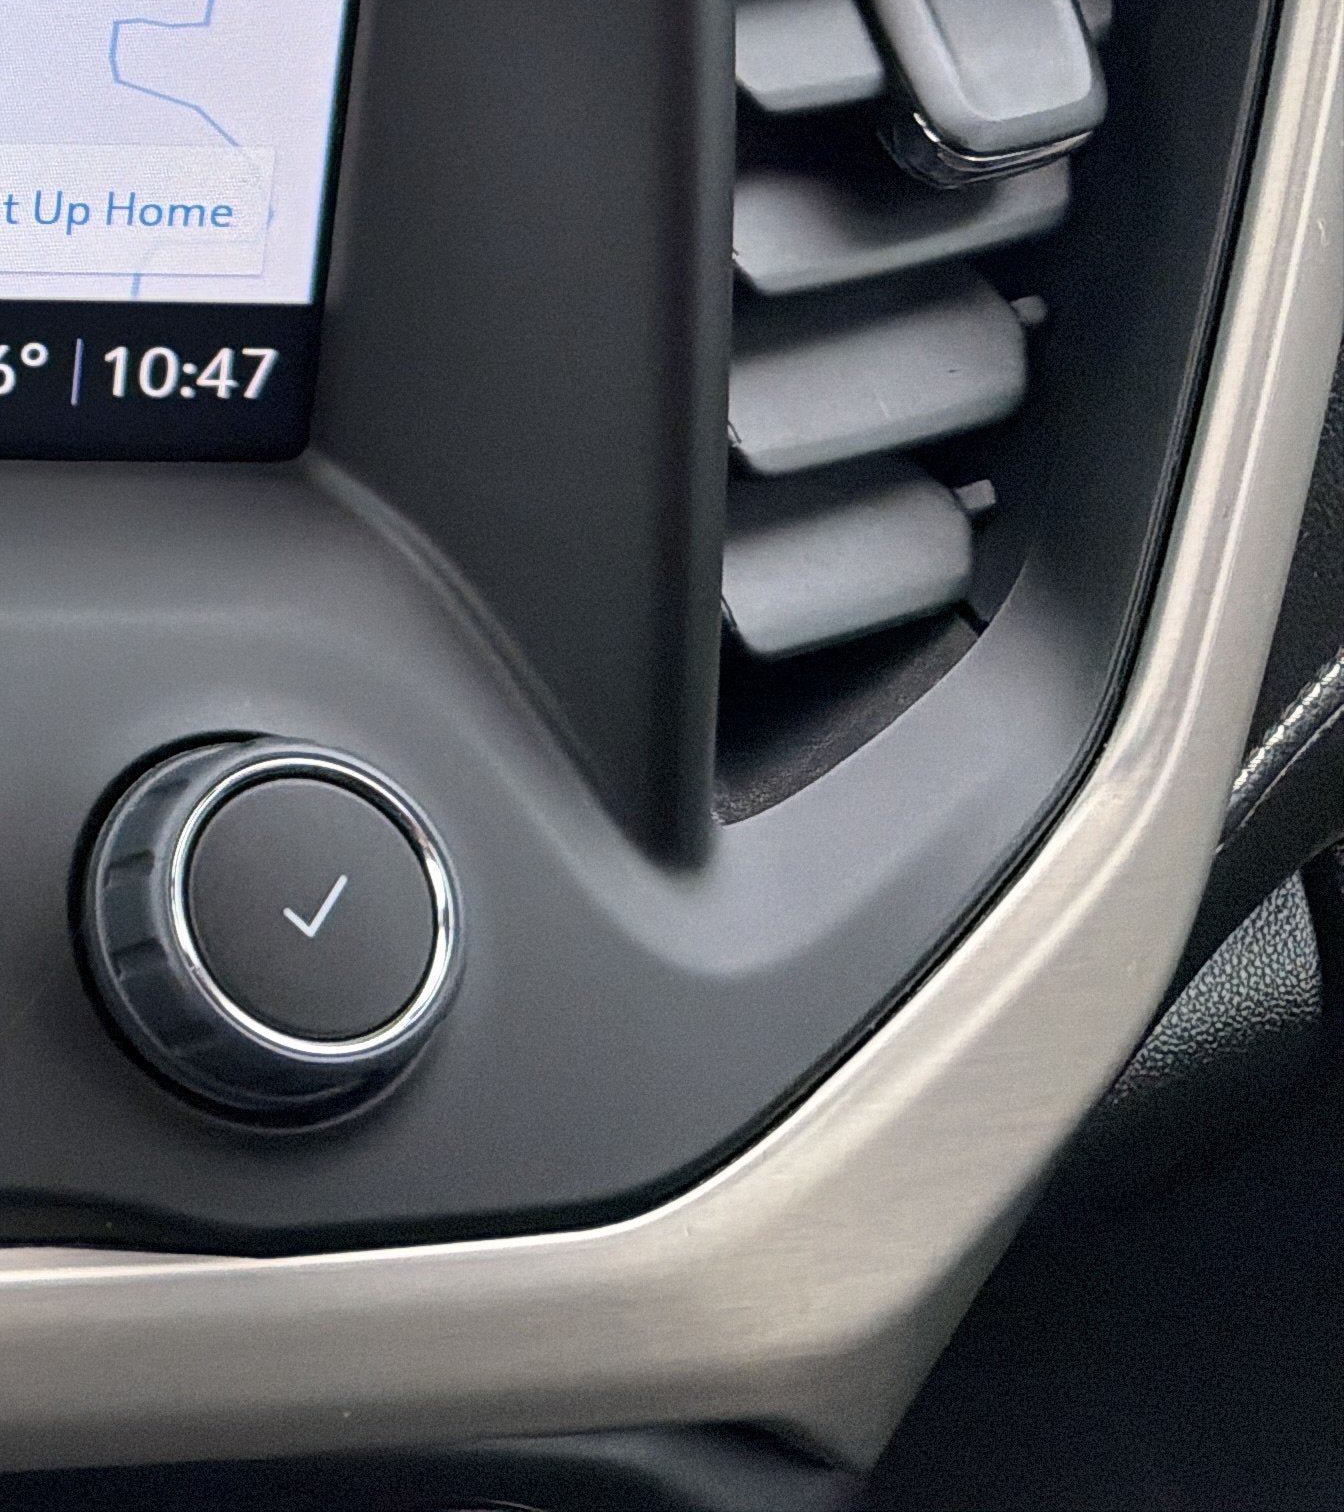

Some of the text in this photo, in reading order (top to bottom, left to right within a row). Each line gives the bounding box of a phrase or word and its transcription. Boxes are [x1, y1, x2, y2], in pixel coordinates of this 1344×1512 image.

[33, 190, 91, 235] Up
[107, 192, 234, 228] Home
[104, 346, 280, 399] 10:47
